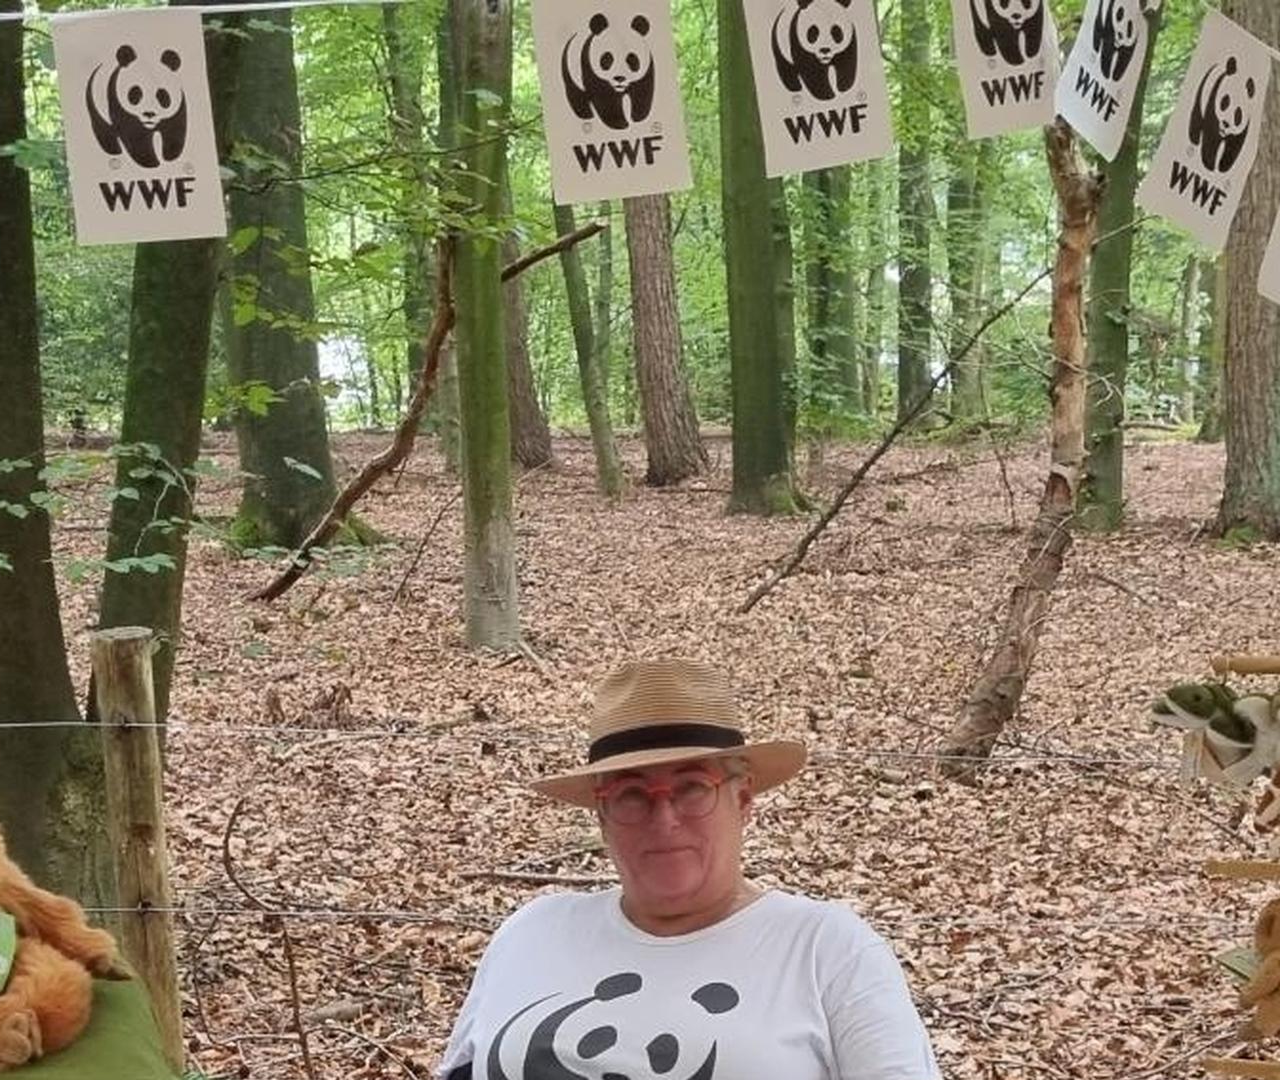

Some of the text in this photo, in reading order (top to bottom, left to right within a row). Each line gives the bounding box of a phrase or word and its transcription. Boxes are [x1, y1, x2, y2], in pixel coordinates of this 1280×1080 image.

[980, 71, 1046, 108] WWF
[1075, 65, 1121, 120] WWF
[783, 103, 868, 145] WWF
[572, 134, 664, 174] WWF
[98, 176, 196, 213] WWF
[1169, 160, 1228, 216] WWF
